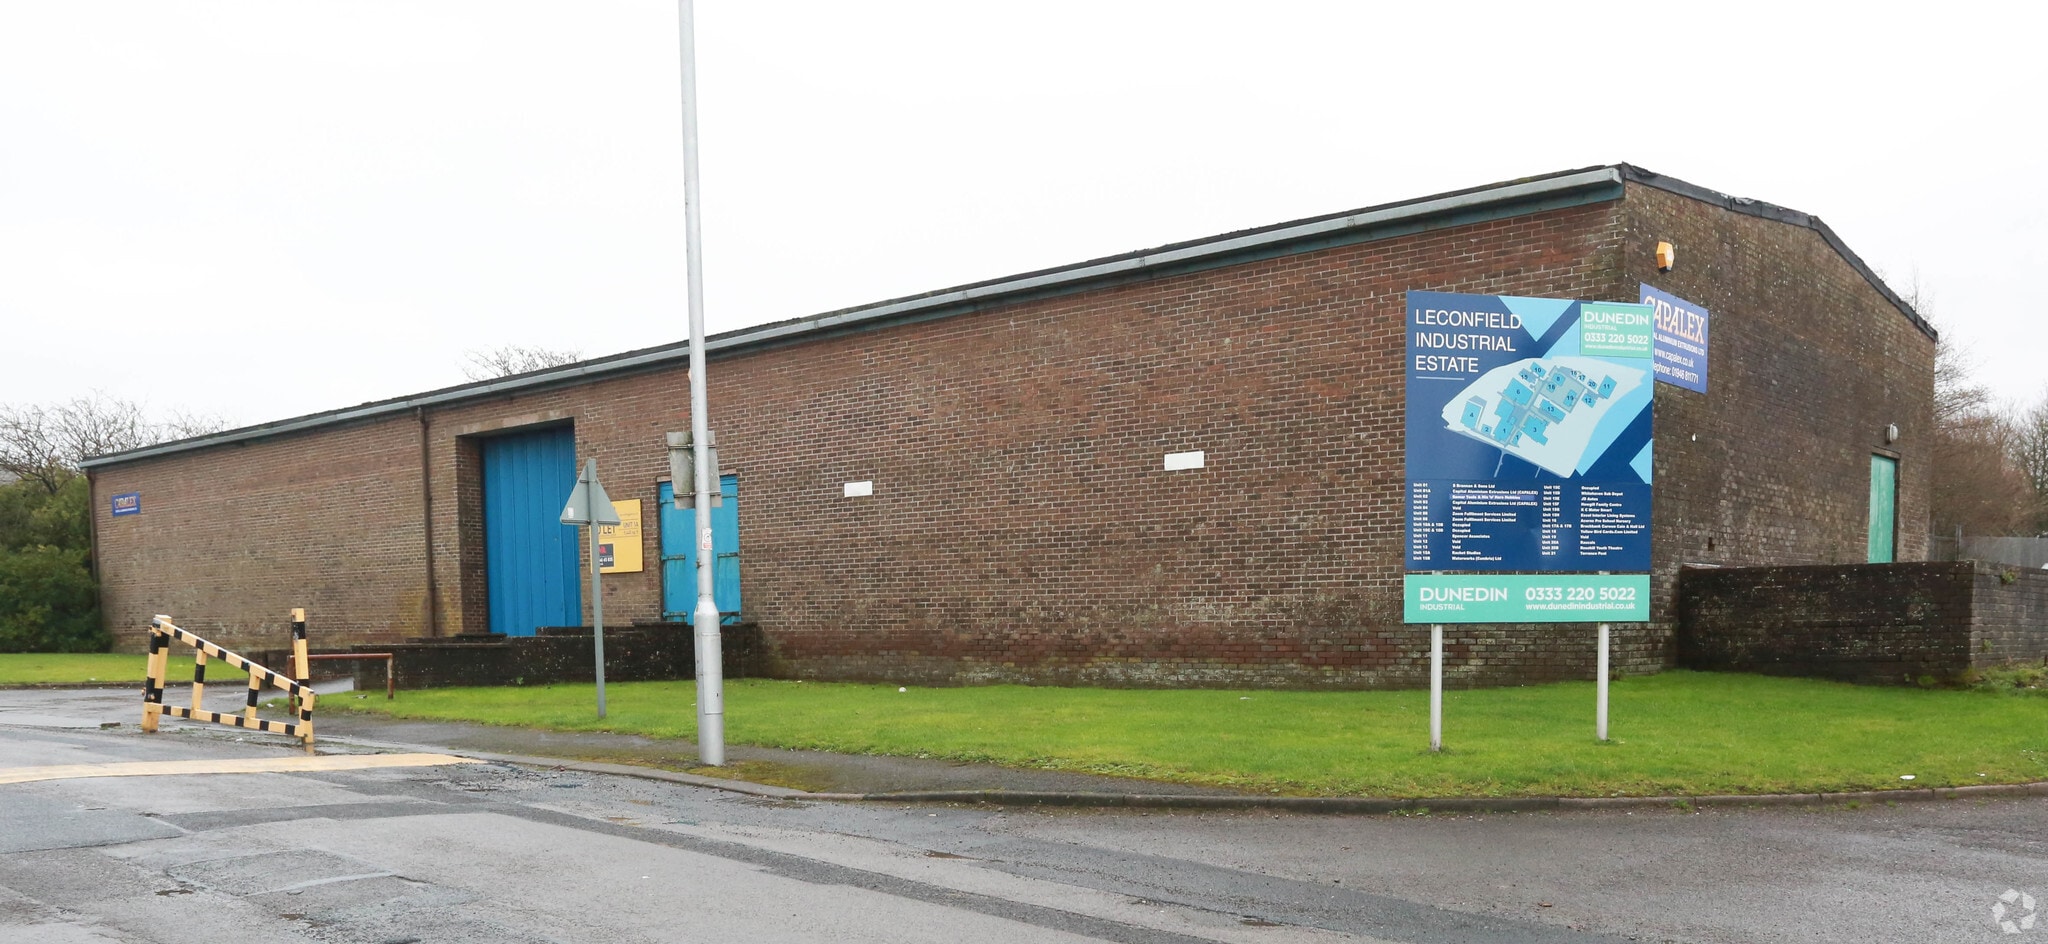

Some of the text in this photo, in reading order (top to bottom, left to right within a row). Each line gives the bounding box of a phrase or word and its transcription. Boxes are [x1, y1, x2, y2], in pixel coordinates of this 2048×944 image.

[1416, 309, 1521, 329] LECONFIELD
[1584, 311, 1649, 325] DUNEDIN
[1584, 323, 1617, 331] INDUSTRIAL
[1416, 332, 1516, 351] INDUSTRIAL
[1584, 332, 1605, 342] 0333
[1608, 333, 1624, 343] 220
[1627, 334, 1648, 344] 5022
[1416, 355, 1479, 372] ESTATE
[1655, 348, 1694, 368] www.capalex.co.uk
[1420, 587, 1507, 602] DUNEDIN
[1525, 587, 1635, 601] 0333 220 5022
